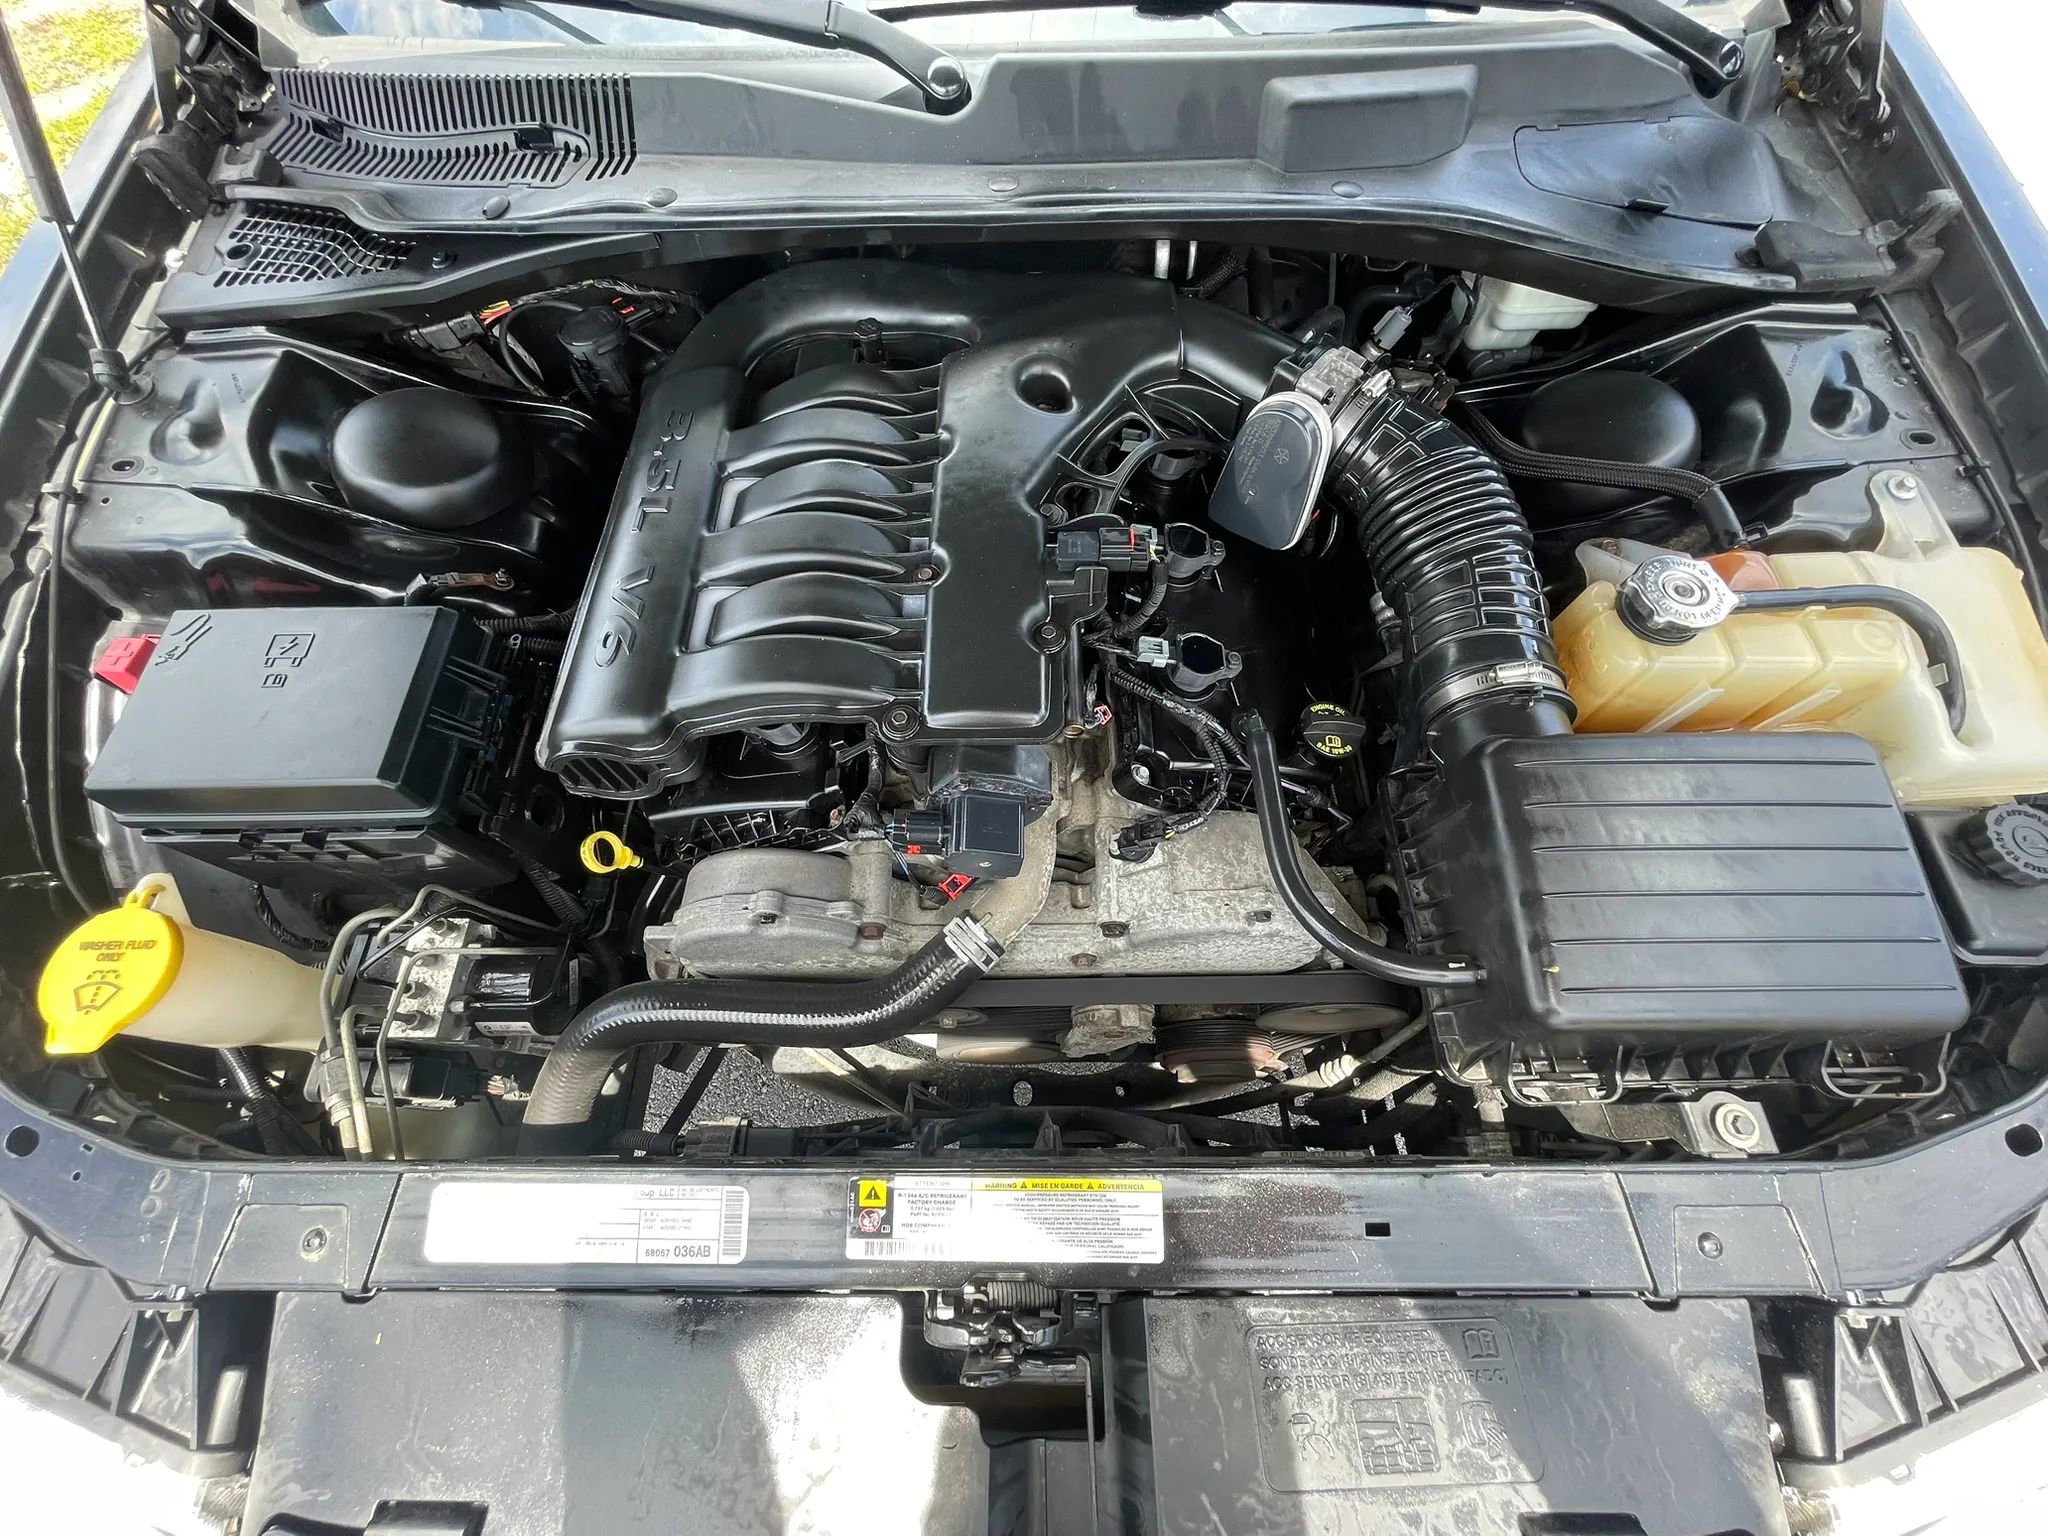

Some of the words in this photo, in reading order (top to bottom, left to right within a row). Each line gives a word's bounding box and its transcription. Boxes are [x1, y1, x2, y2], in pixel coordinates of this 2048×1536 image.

[631, 410, 694, 533] 3.5L
[593, 565, 656, 668] V6
[1310, 703, 1335, 713] ENGINE
[1335, 706, 1346, 716] OIL
[1316, 742, 1331, 753] SAE
[79, 940, 124, 951] WASHER
[125, 939, 158, 950] FLUID
[96, 952, 125, 962] ONLY
[984, 1182, 1018, 1190] WARNING
[1031, 1182, 1049, 1190] MISE
[1050, 1182, 1060, 1190] EN
[1060, 1182, 1084, 1190] GARDE
[1097, 1183, 1145, 1191] ADVERTENCIA
[658, 1188, 675, 1197] LLC
[645, 1249, 670, 1257] 68067
[673, 1245, 711, 1258] 036AB
[1286, 1331, 1340, 1348] SENSOR
[1260, 1354, 1307, 1370] SONDE
[1294, 1373, 1350, 1390] SENSOR
